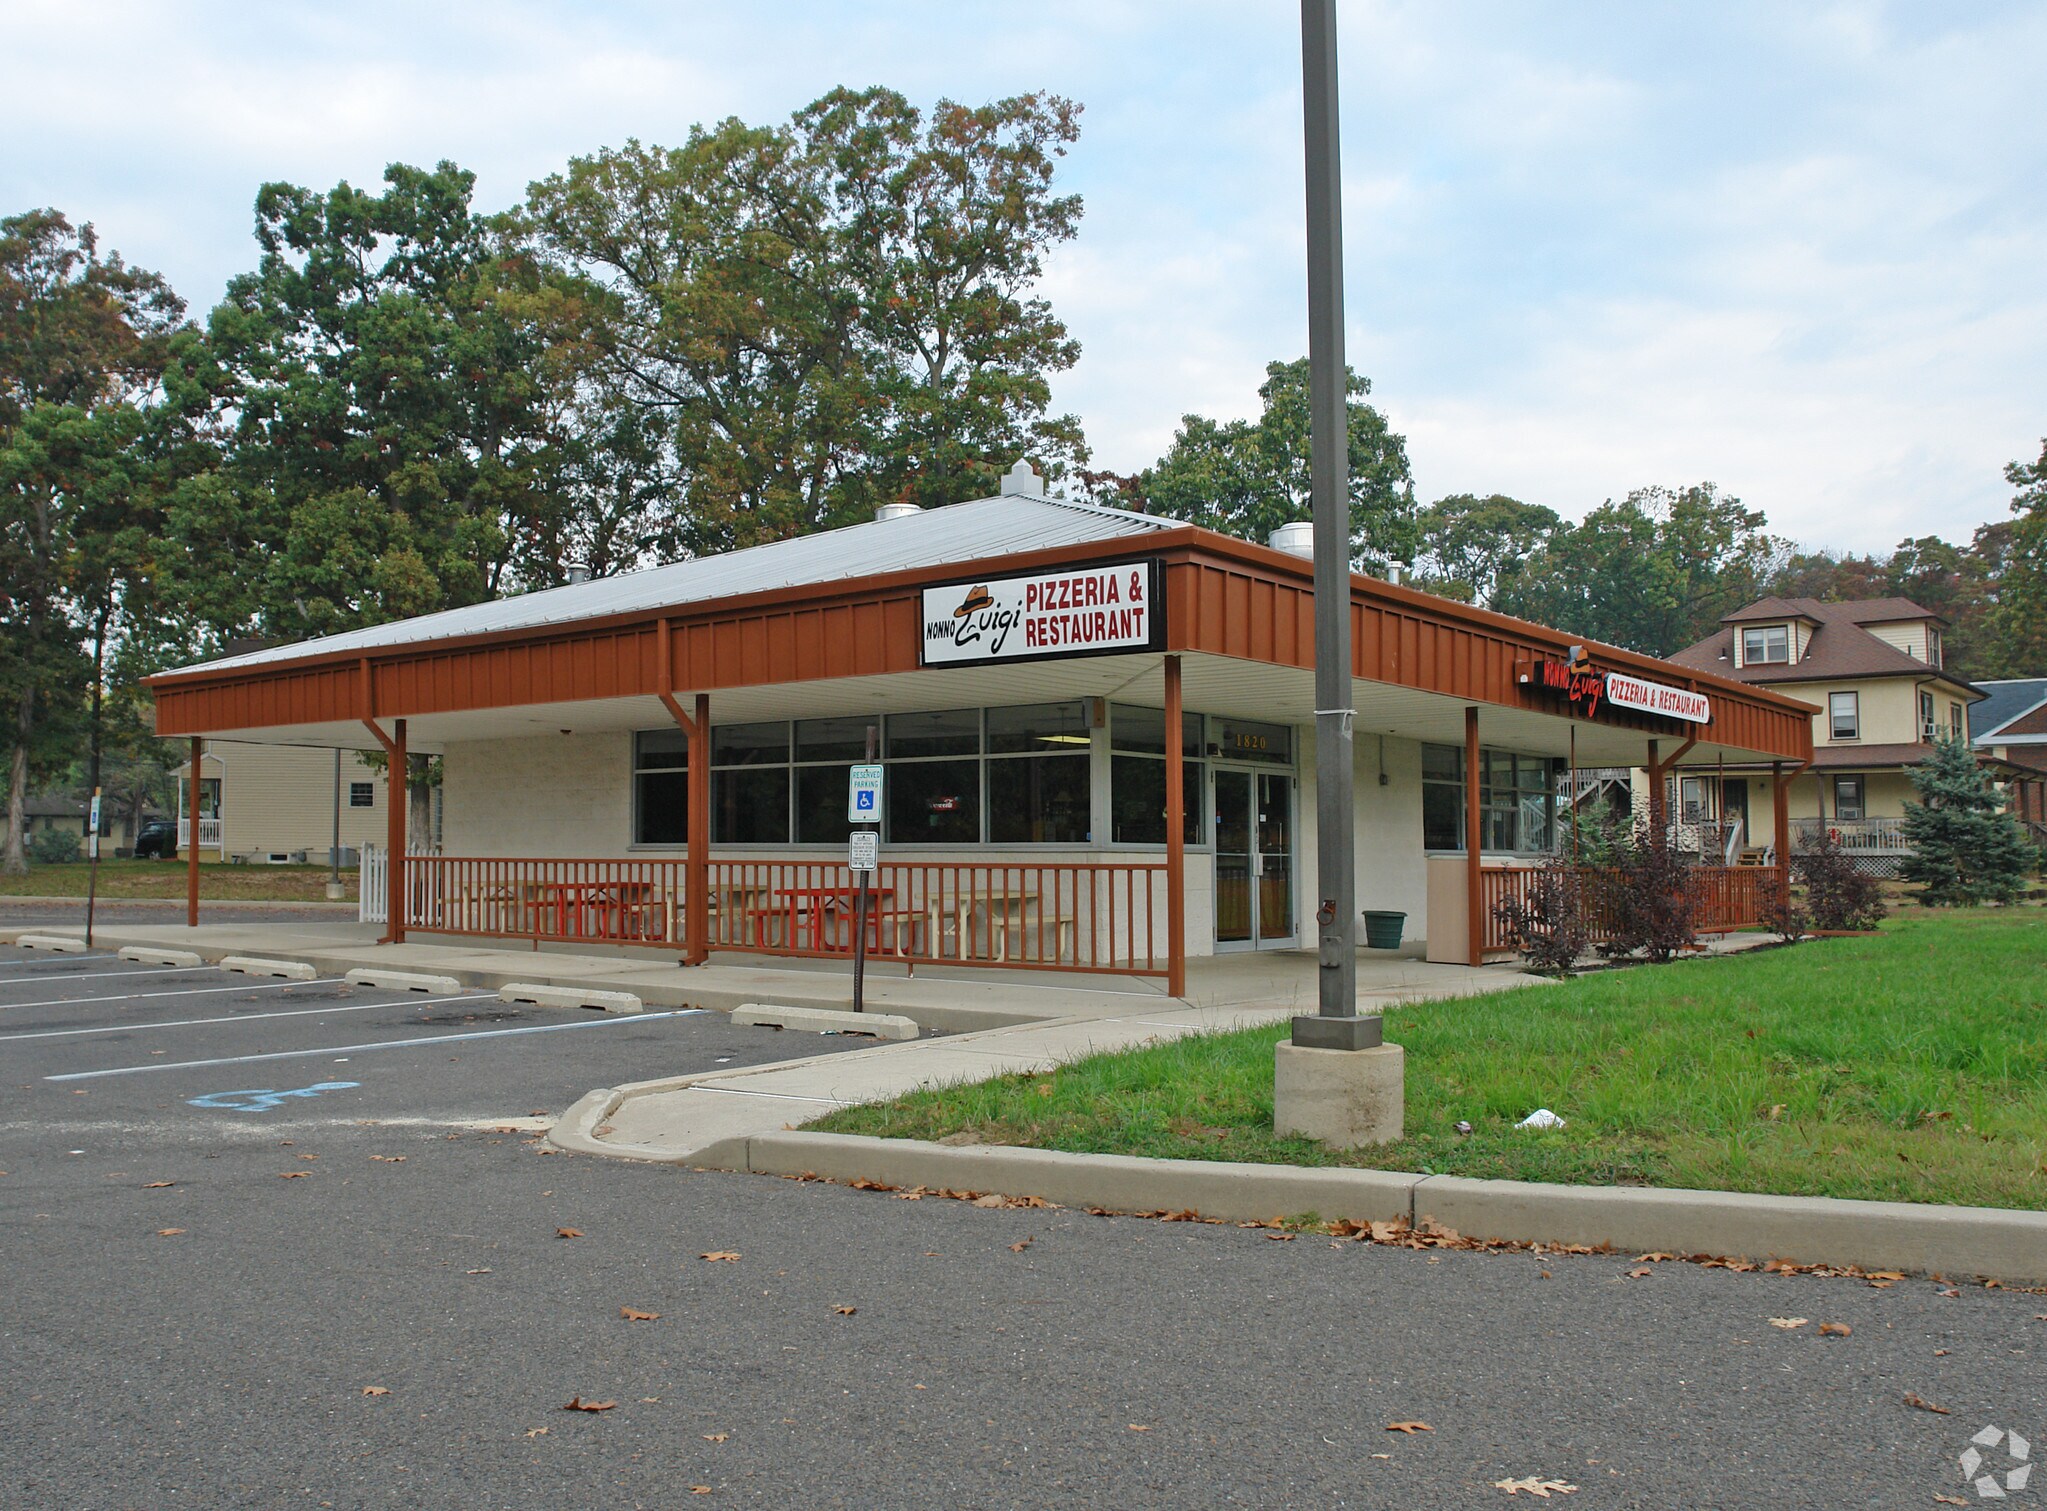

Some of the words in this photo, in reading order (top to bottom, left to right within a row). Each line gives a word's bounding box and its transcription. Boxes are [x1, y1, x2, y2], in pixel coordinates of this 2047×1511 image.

[1026, 574, 1120, 613] PIZZERIA
[1128, 570, 1143, 602] &
[926, 619, 956, 640] NONNO
[954, 600, 1023, 655] Luigi
[1025, 607, 1144, 648] RESTAURANT
[1609, 678, 1648, 706] PIZZERIA
[1650, 691, 1656, 708] &
[1658, 690, 1707, 719] RESTAURANT
[1236, 734, 1266, 750] 1820
[852, 770, 880, 779] RESERVED
[854, 780, 879, 788] PARKING
